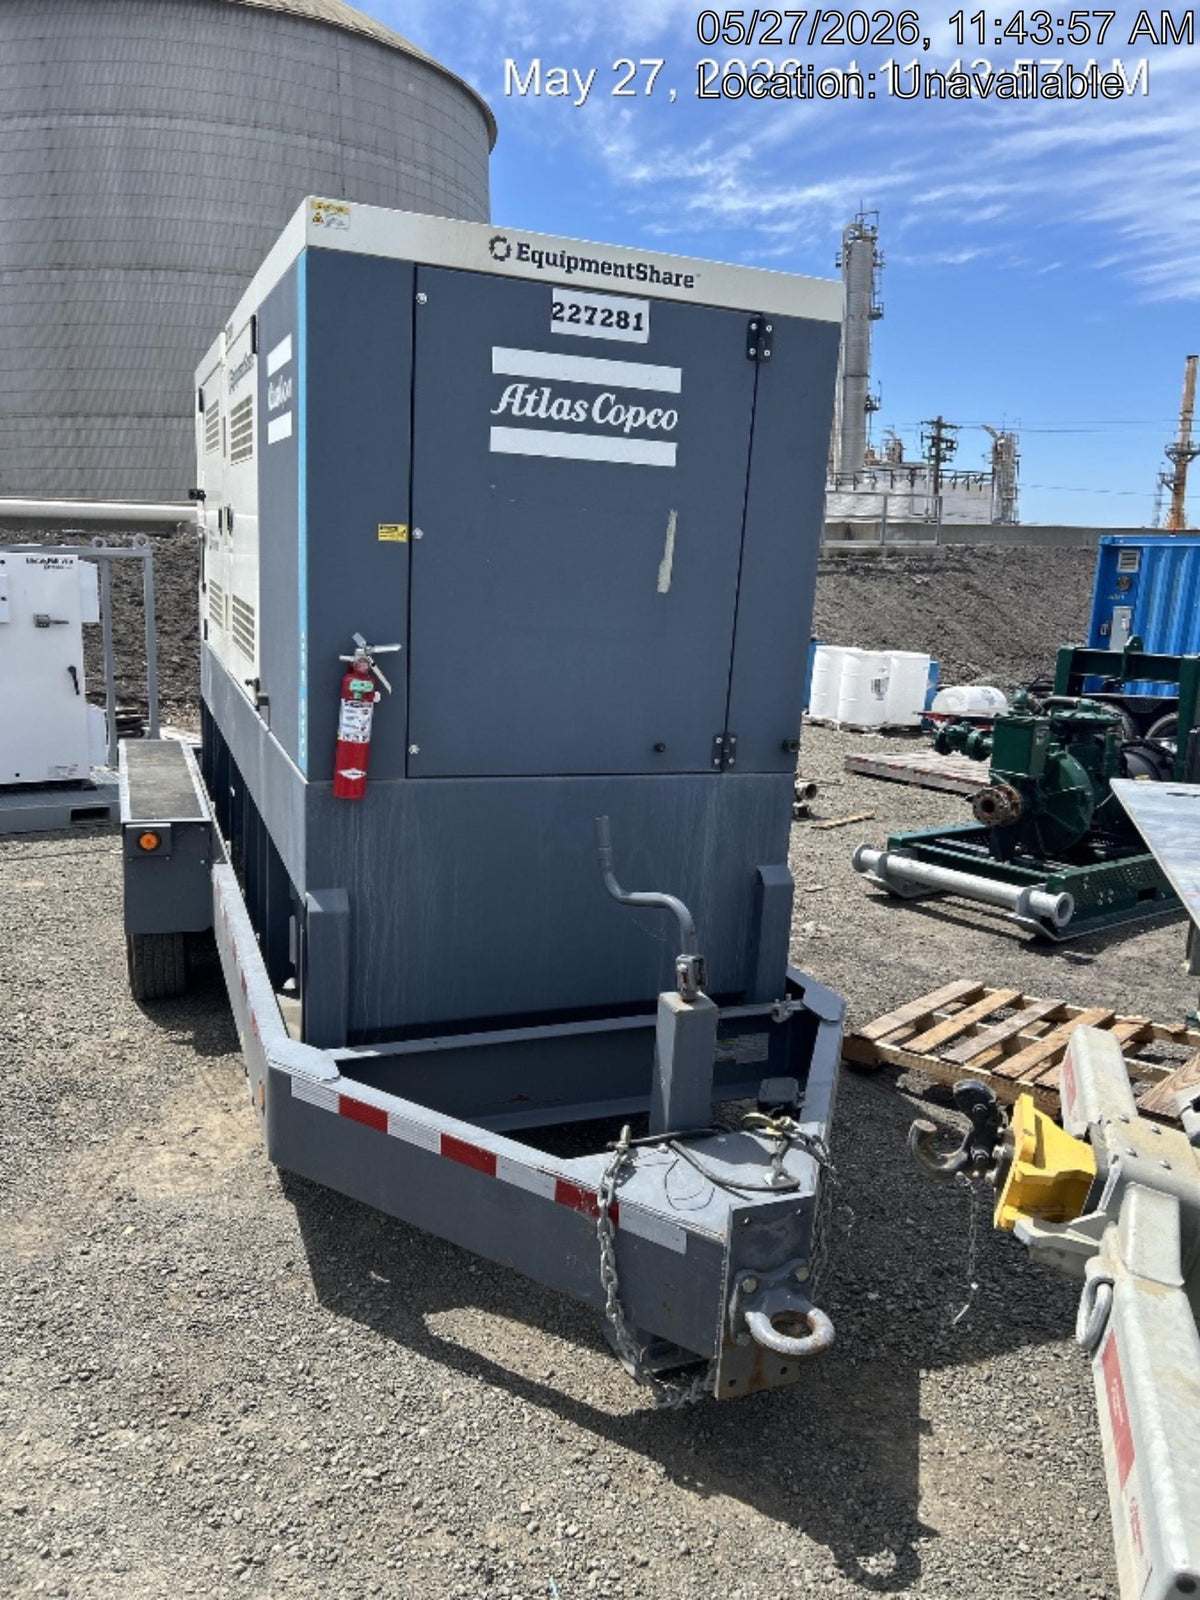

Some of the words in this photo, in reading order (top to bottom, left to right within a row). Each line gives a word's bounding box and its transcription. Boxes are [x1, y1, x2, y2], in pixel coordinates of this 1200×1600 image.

[516, 242, 695, 288] EquipmentShare
[552, 302, 645, 332] 227281
[490, 383, 589, 423] Atlas
[591, 392, 679, 434] Copco
